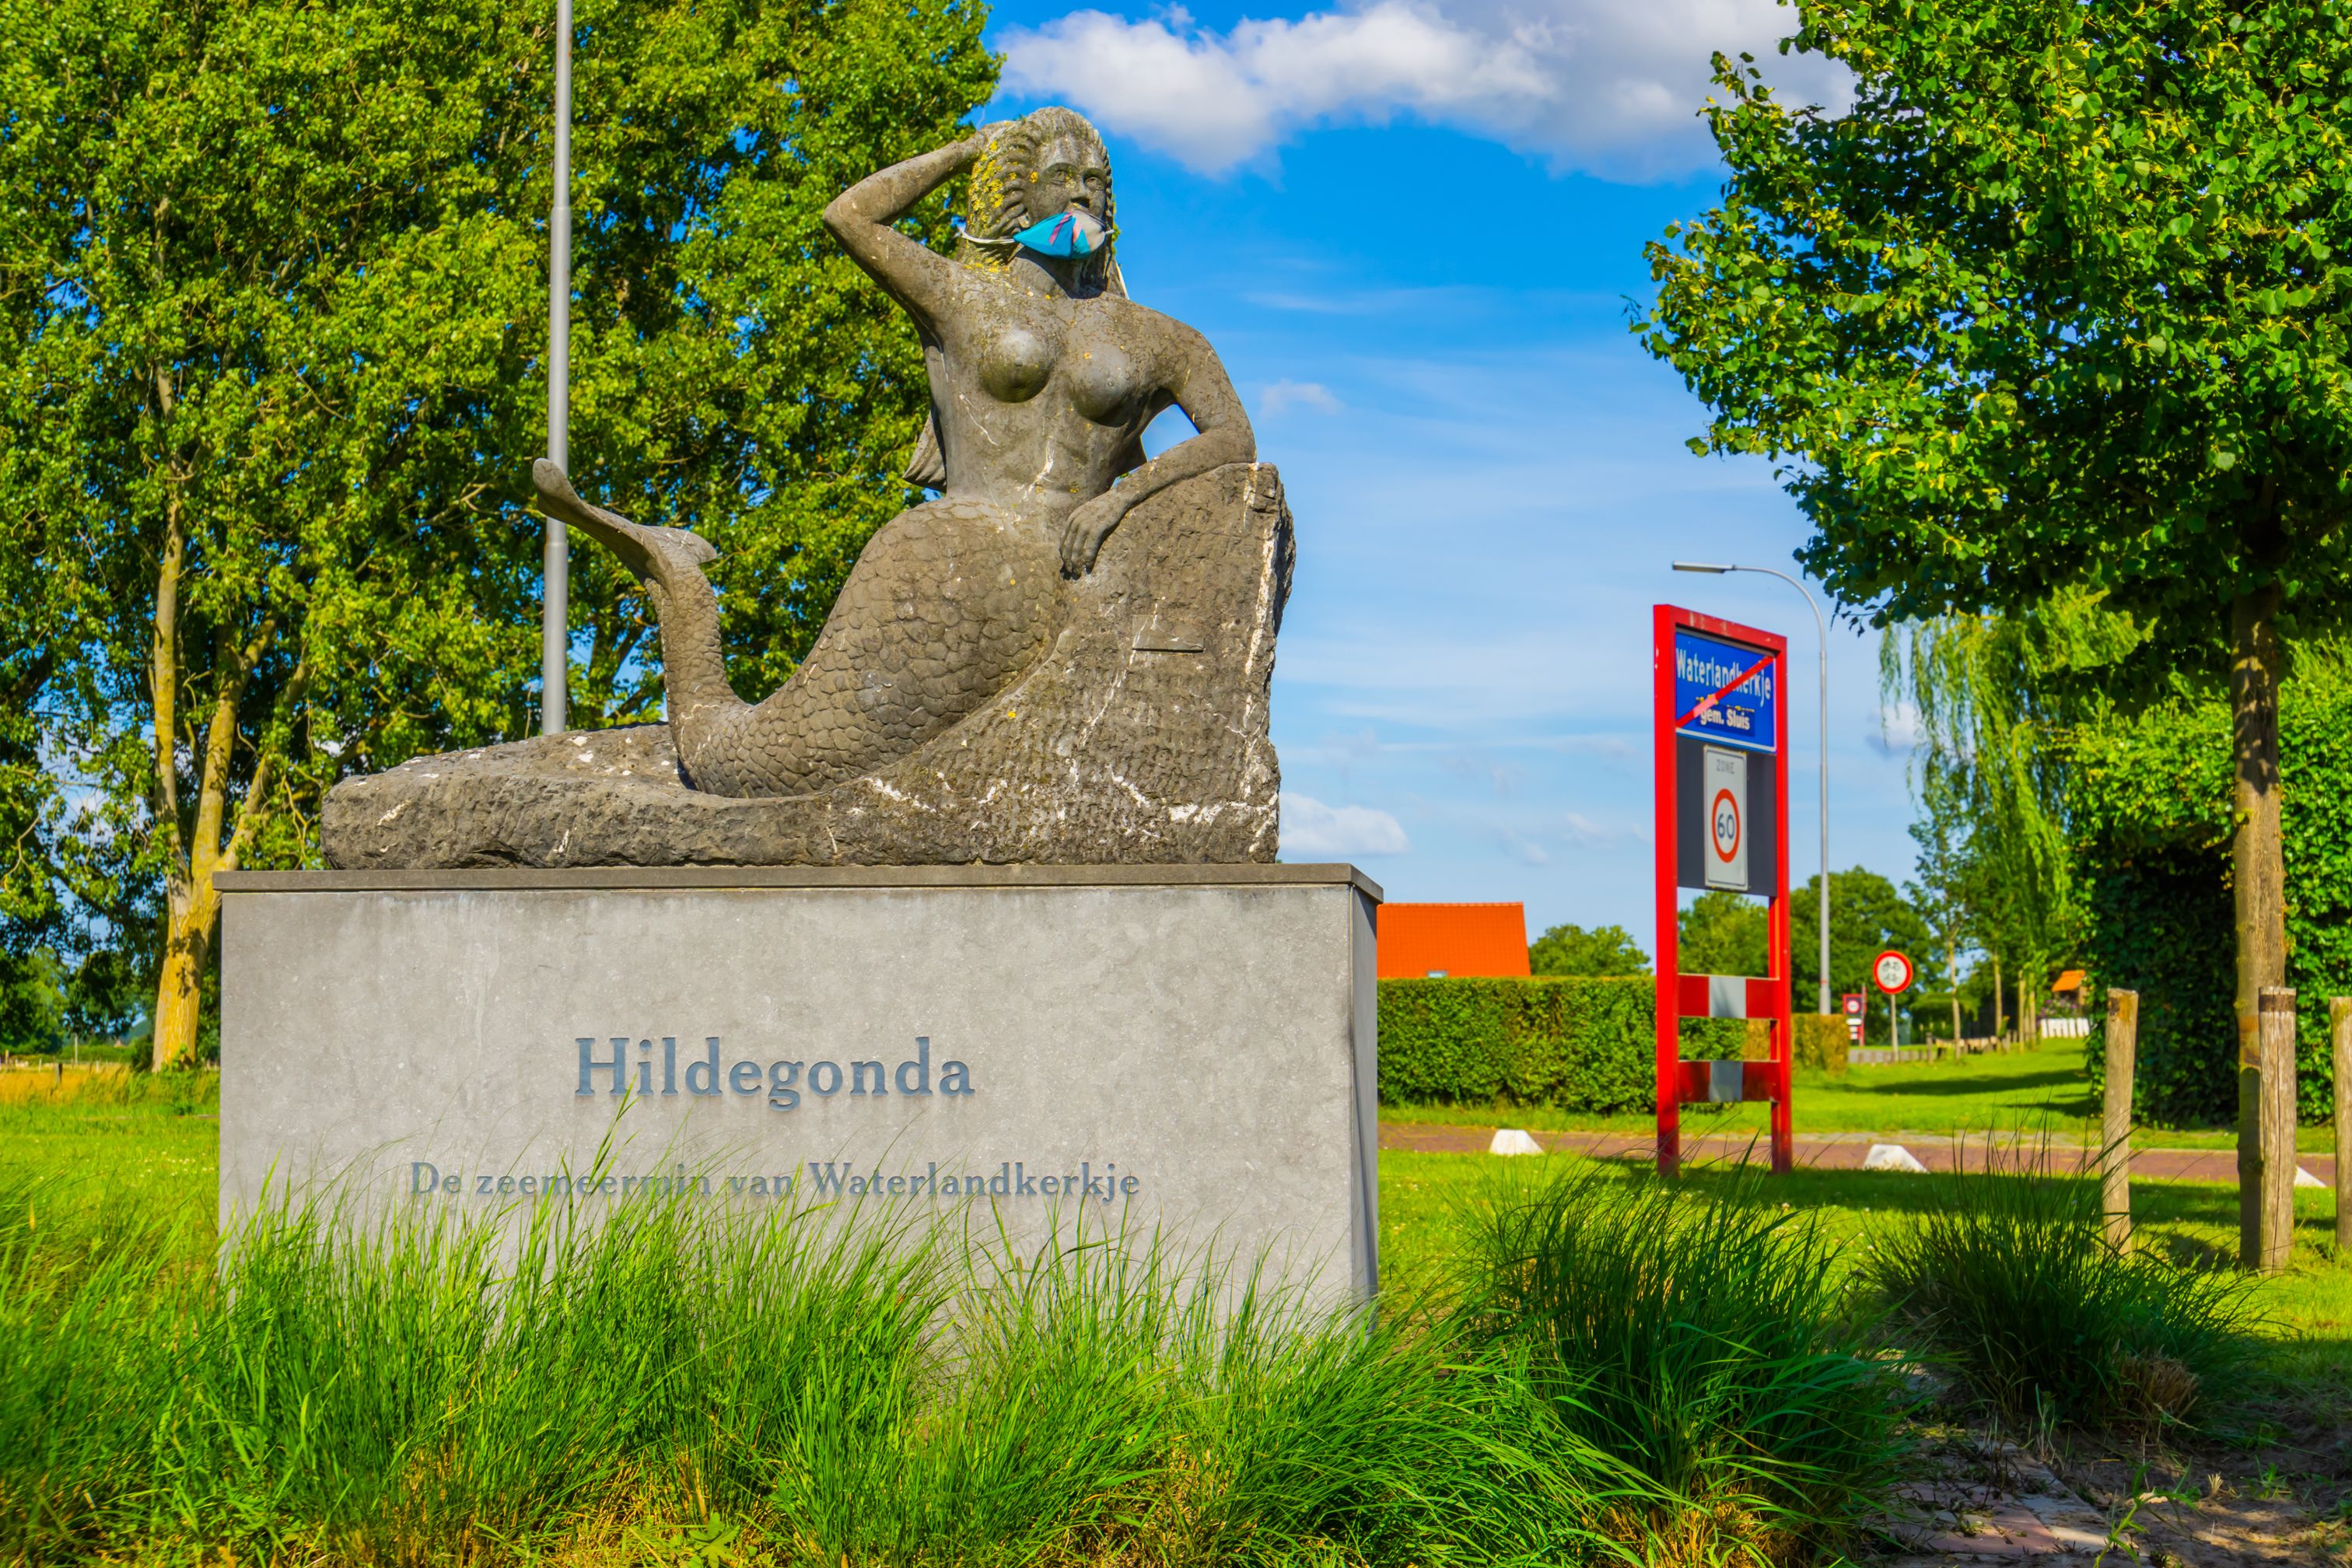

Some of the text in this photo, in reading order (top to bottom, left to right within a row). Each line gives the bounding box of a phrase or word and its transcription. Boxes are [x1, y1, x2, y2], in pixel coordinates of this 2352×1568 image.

[1676, 647, 1772, 708] Waterlandkerkje
[1700, 709, 1750, 730] gem. Sluis
[1716, 758, 1735, 775] ZONE
[1717, 812, 1735, 840] 60
[574, 1035, 976, 1112] Hildegonda
[411, 1161, 1140, 1202] De zeemeermin van Waterlandkerkje
